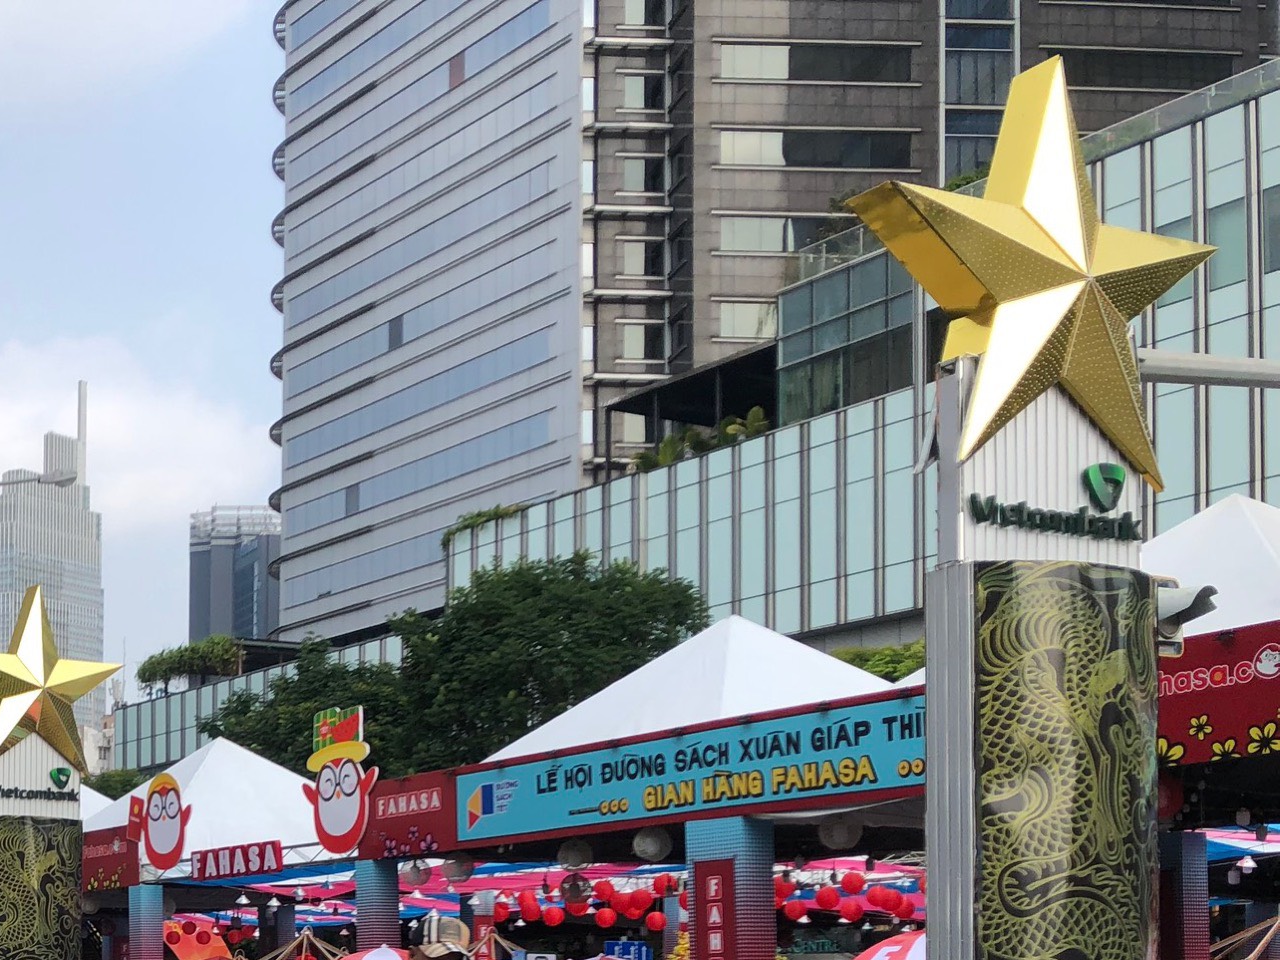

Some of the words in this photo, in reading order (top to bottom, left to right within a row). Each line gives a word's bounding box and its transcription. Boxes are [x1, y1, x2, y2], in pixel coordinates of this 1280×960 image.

[970, 492, 1142, 541] Vietcombank
[536, 764, 563, 794] LỄ
[565, 763, 592, 794] HỘI
[675, 740, 729, 772] SÁCH
[739, 730, 801, 763] XUÂN
[811, 717, 871, 752] GIÁP
[883, 706, 926, 742] THÌ
[377, 791, 441, 816] FAHASA
[643, 778, 695, 812] GIAN
[702, 770, 764, 802] HÀNG
[772, 755, 879, 795] FAHASA
[192, 844, 278, 879] FAHASA
